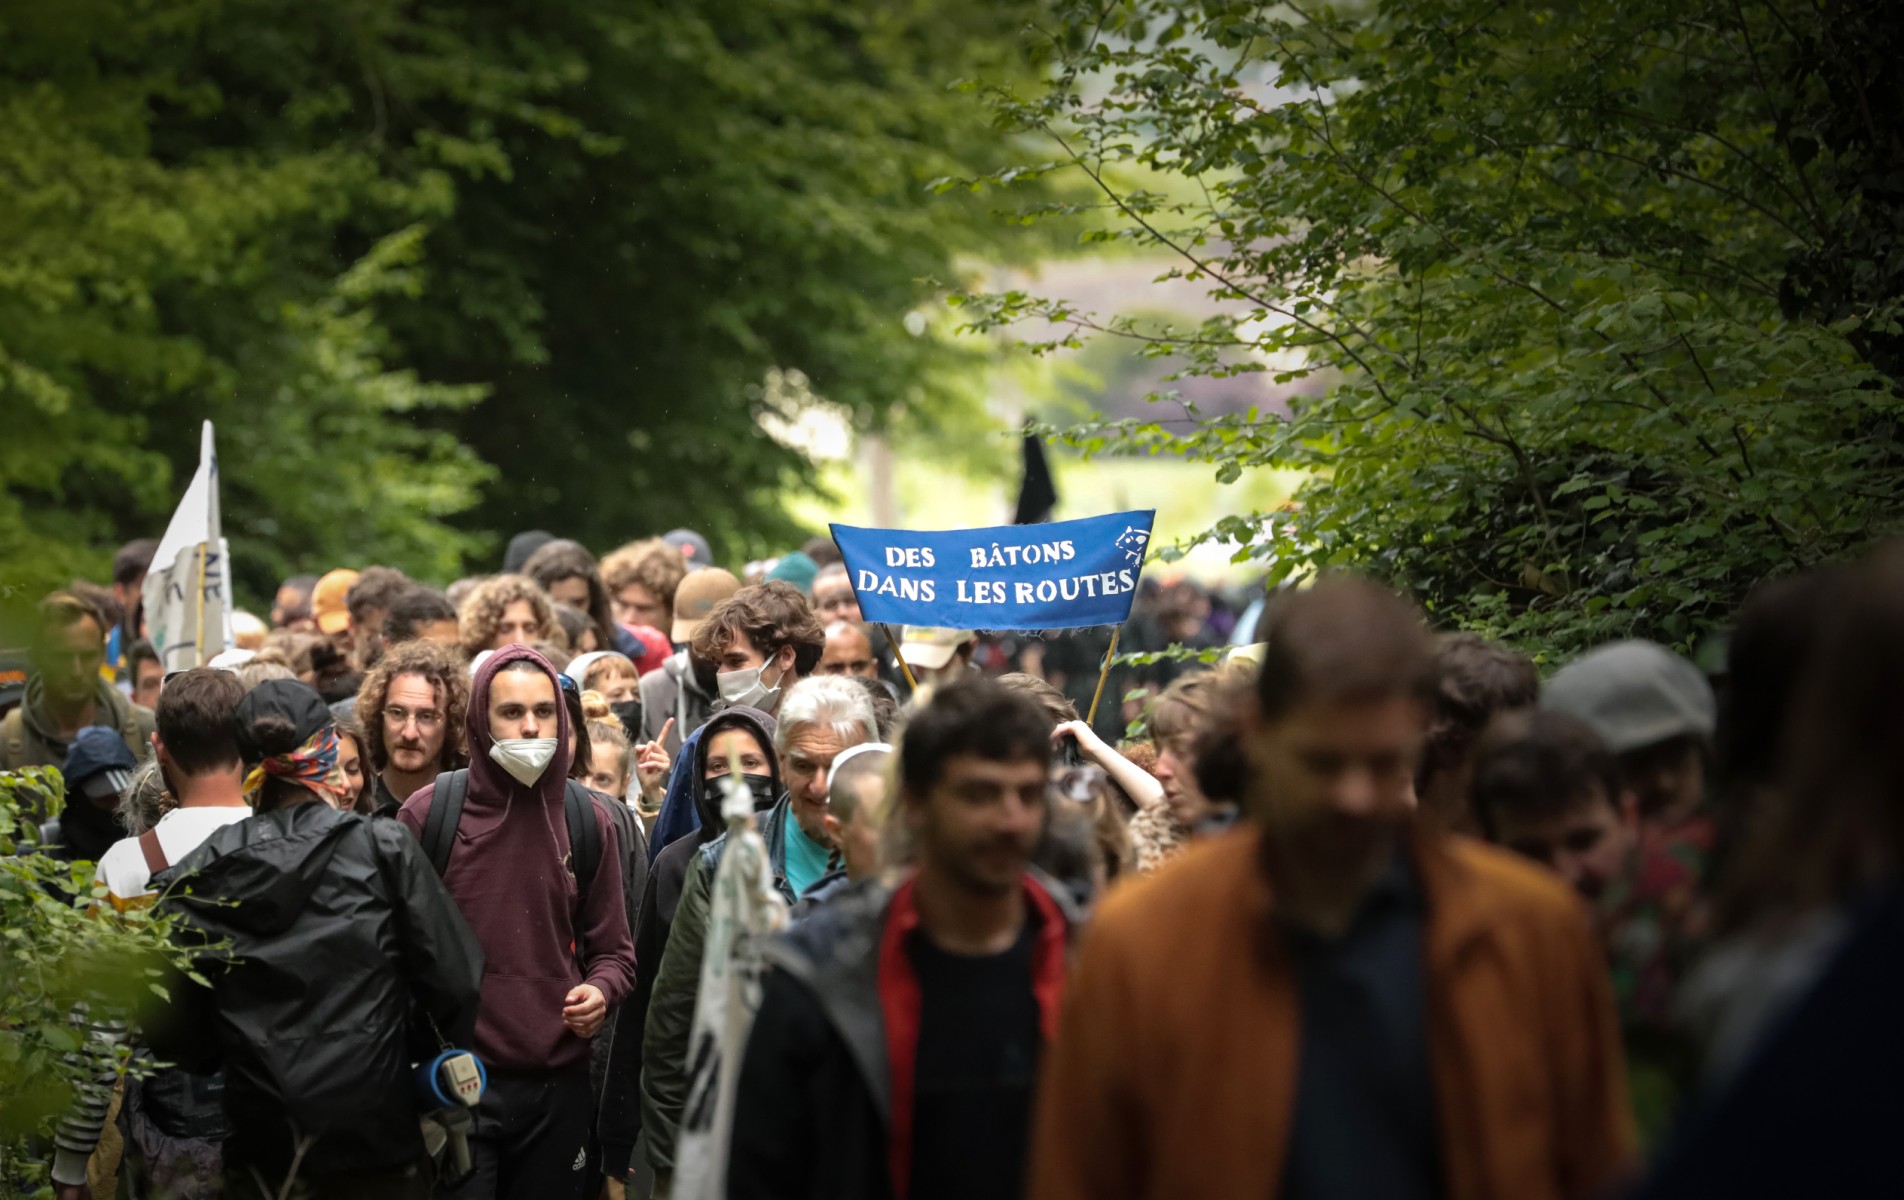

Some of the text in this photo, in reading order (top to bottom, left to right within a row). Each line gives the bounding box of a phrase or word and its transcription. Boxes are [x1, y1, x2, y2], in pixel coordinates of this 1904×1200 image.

[886, 540, 1075, 568] DES BÂTONS
[857, 569, 1135, 604] DANS LES ROUTES
